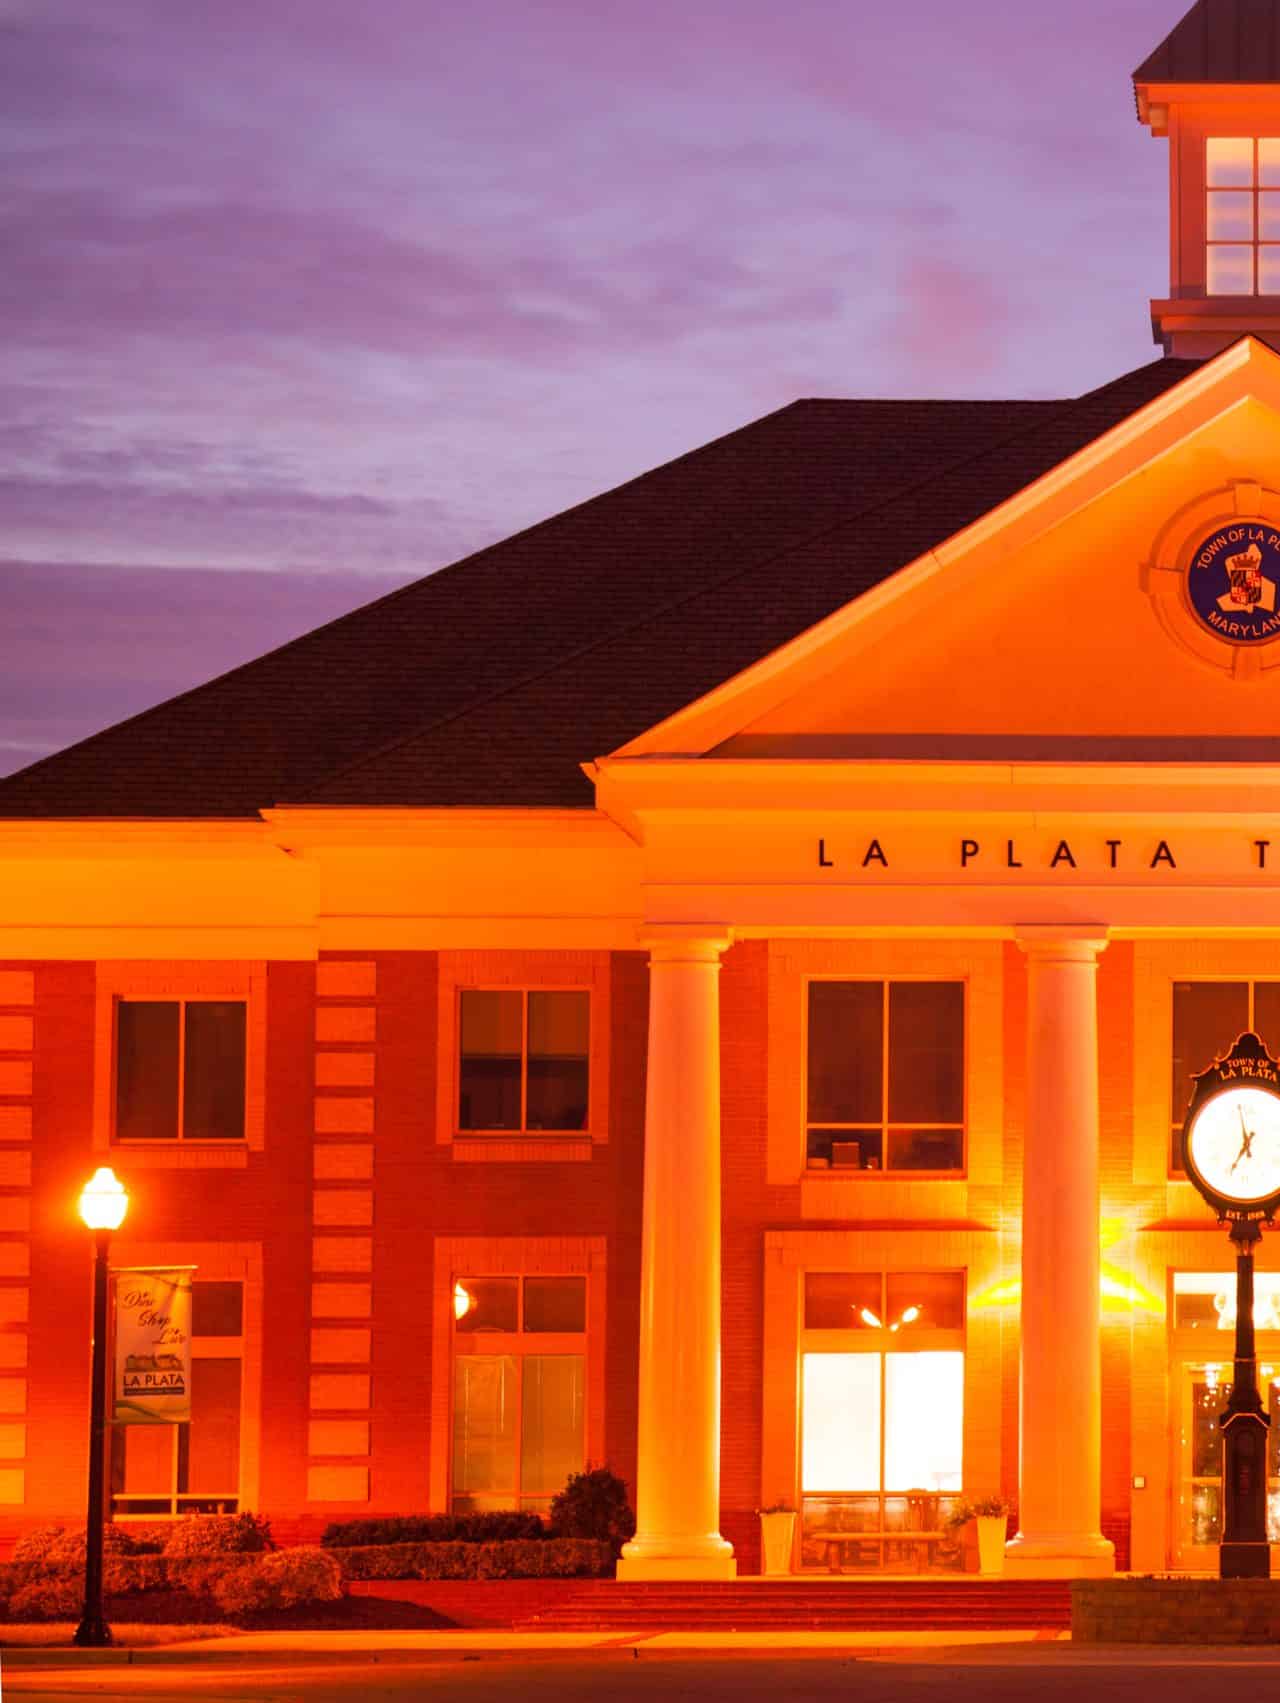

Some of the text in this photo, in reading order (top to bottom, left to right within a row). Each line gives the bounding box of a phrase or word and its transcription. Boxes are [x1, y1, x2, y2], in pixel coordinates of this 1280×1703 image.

[1196, 535, 1228, 570] TOWN
[1228, 528, 1246, 542] OF
[1248, 528, 1265, 543] LA
[819, 839, 888, 867] LA
[961, 839, 1176, 868] PLATA
[1227, 1058, 1271, 1068] TOWN OF
[1219, 1067, 1278, 1082] LA PLATA
[137, 1309, 170, 1331] Shop
[123, 1373, 185, 1387] LA PLATA
